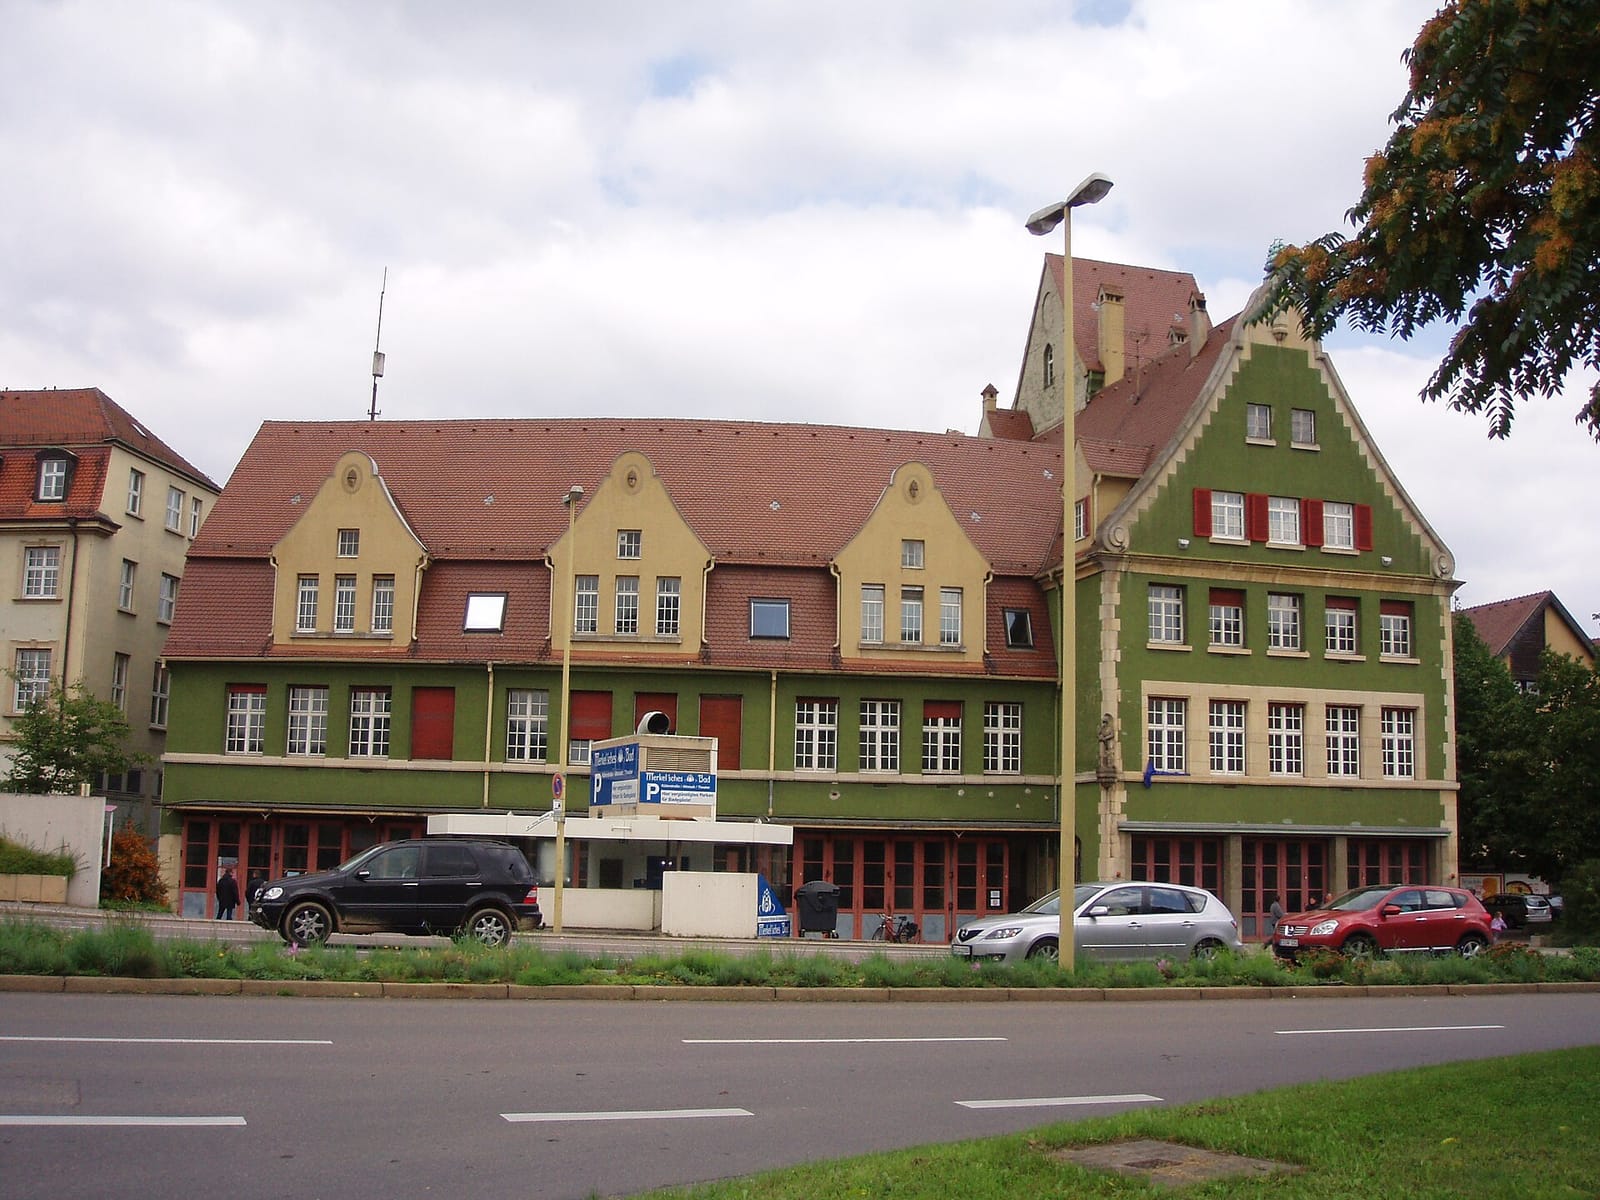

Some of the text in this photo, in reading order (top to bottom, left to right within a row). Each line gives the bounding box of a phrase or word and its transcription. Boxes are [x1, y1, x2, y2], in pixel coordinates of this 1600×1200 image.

[625, 747, 635, 762] Bad
[698, 774, 711, 783] Bad
[593, 773, 602, 803] P
[646, 783, 660, 801] P
